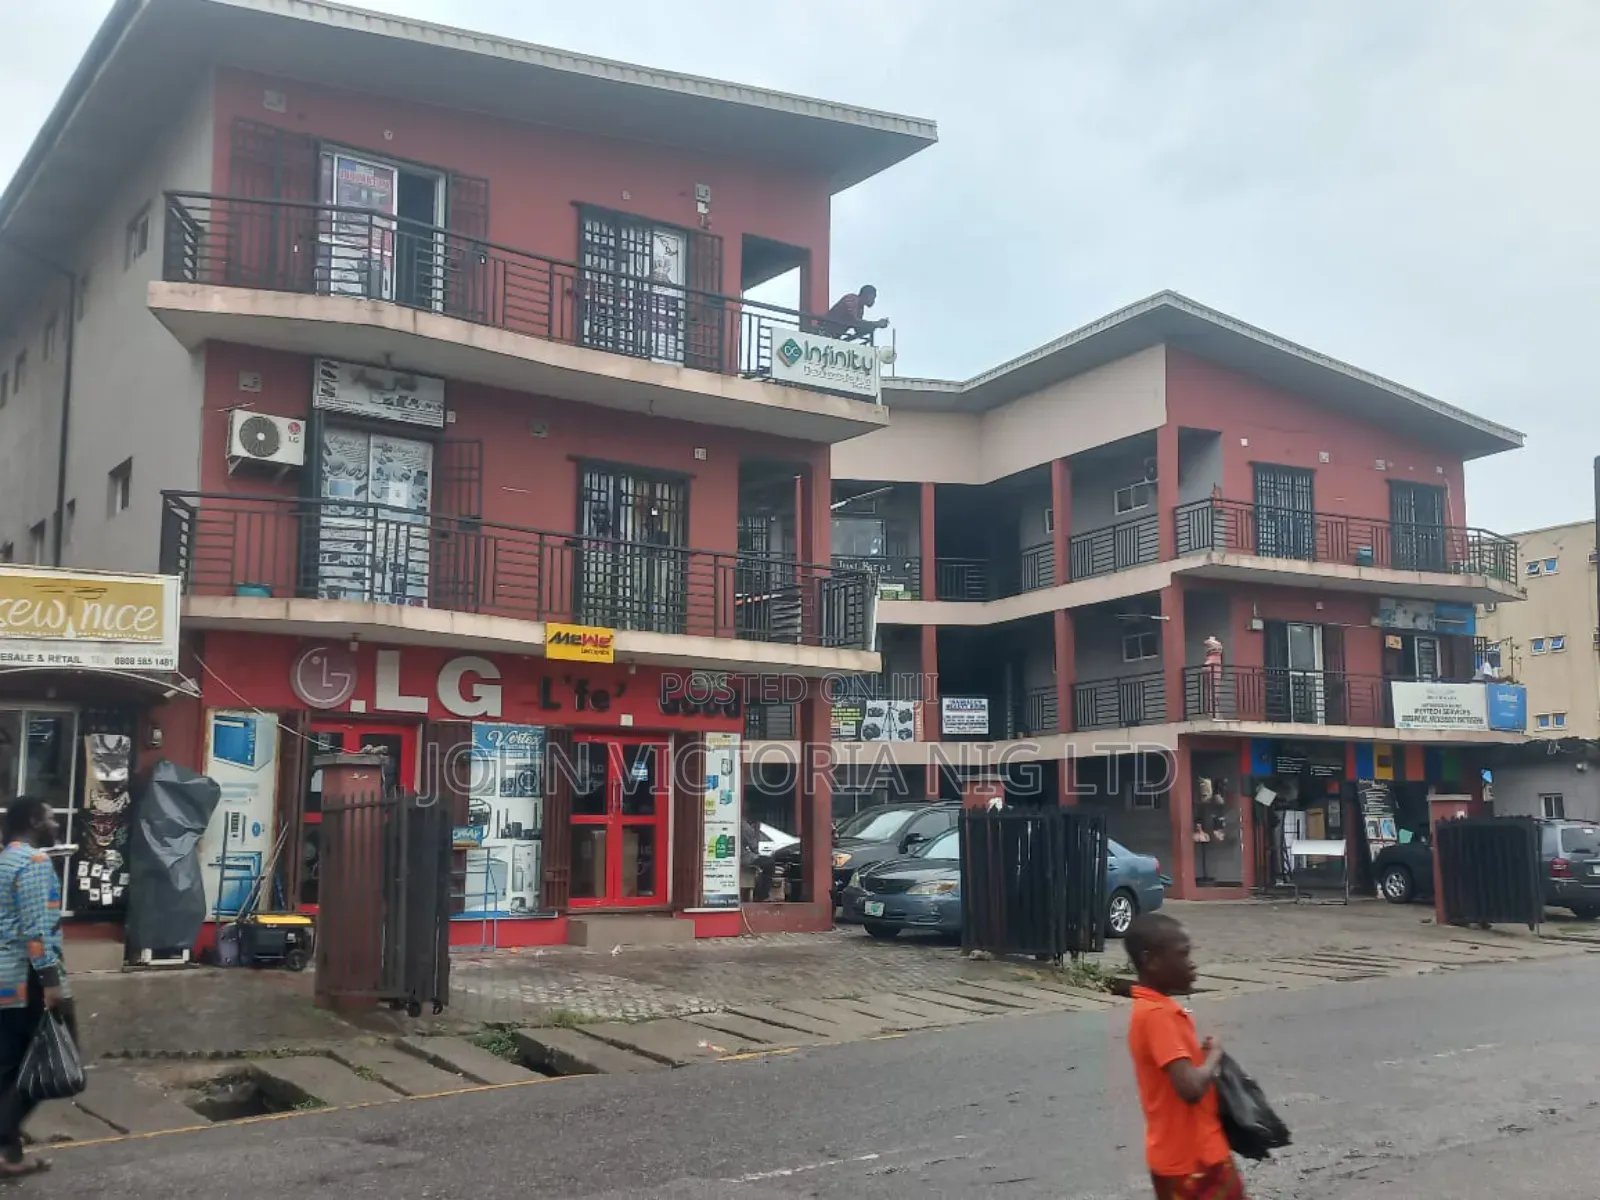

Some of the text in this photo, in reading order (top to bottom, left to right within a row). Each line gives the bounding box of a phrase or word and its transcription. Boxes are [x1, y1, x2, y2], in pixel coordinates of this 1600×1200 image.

[804, 340, 873, 375] Infinity
[48, 655, 82, 664] RETAIL
[375, 650, 502, 717] LG
